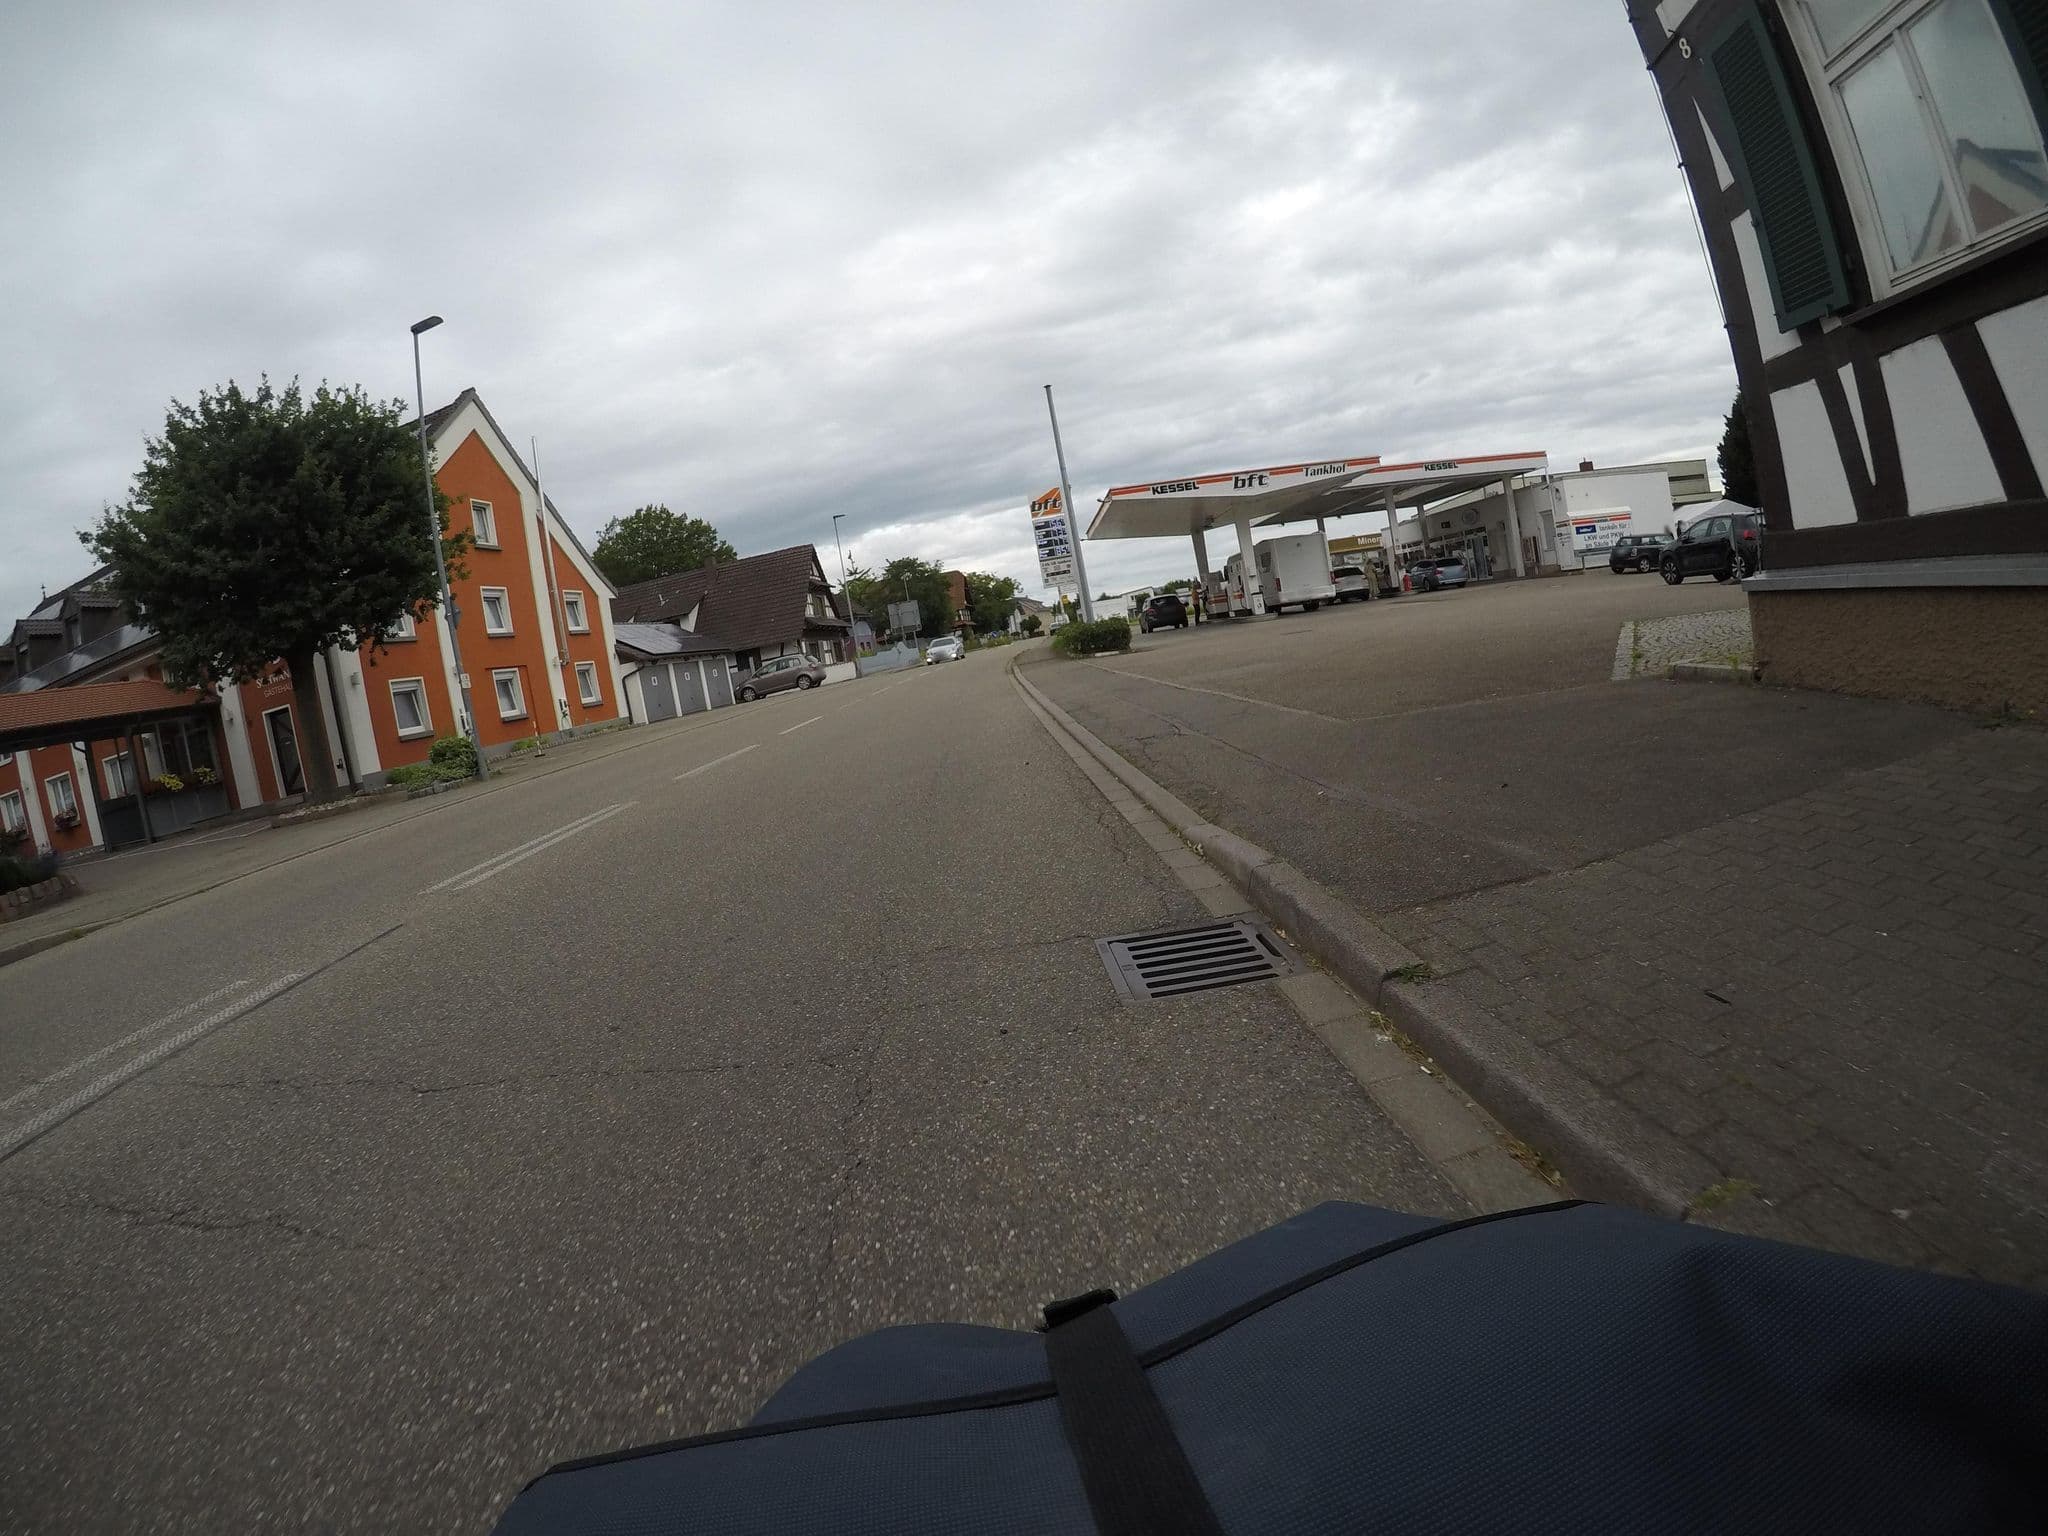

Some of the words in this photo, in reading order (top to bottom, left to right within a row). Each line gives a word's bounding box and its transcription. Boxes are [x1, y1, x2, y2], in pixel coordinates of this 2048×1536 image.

[1679, 38, 1691, 59] 8
[1423, 462, 1459, 472] KESSEL
[1151, 481, 1199, 495] KESSEL
[1233, 473, 1270, 489] bft
[1303, 464, 1346, 477] Tankhof
[1030, 498, 1062, 512] bft
